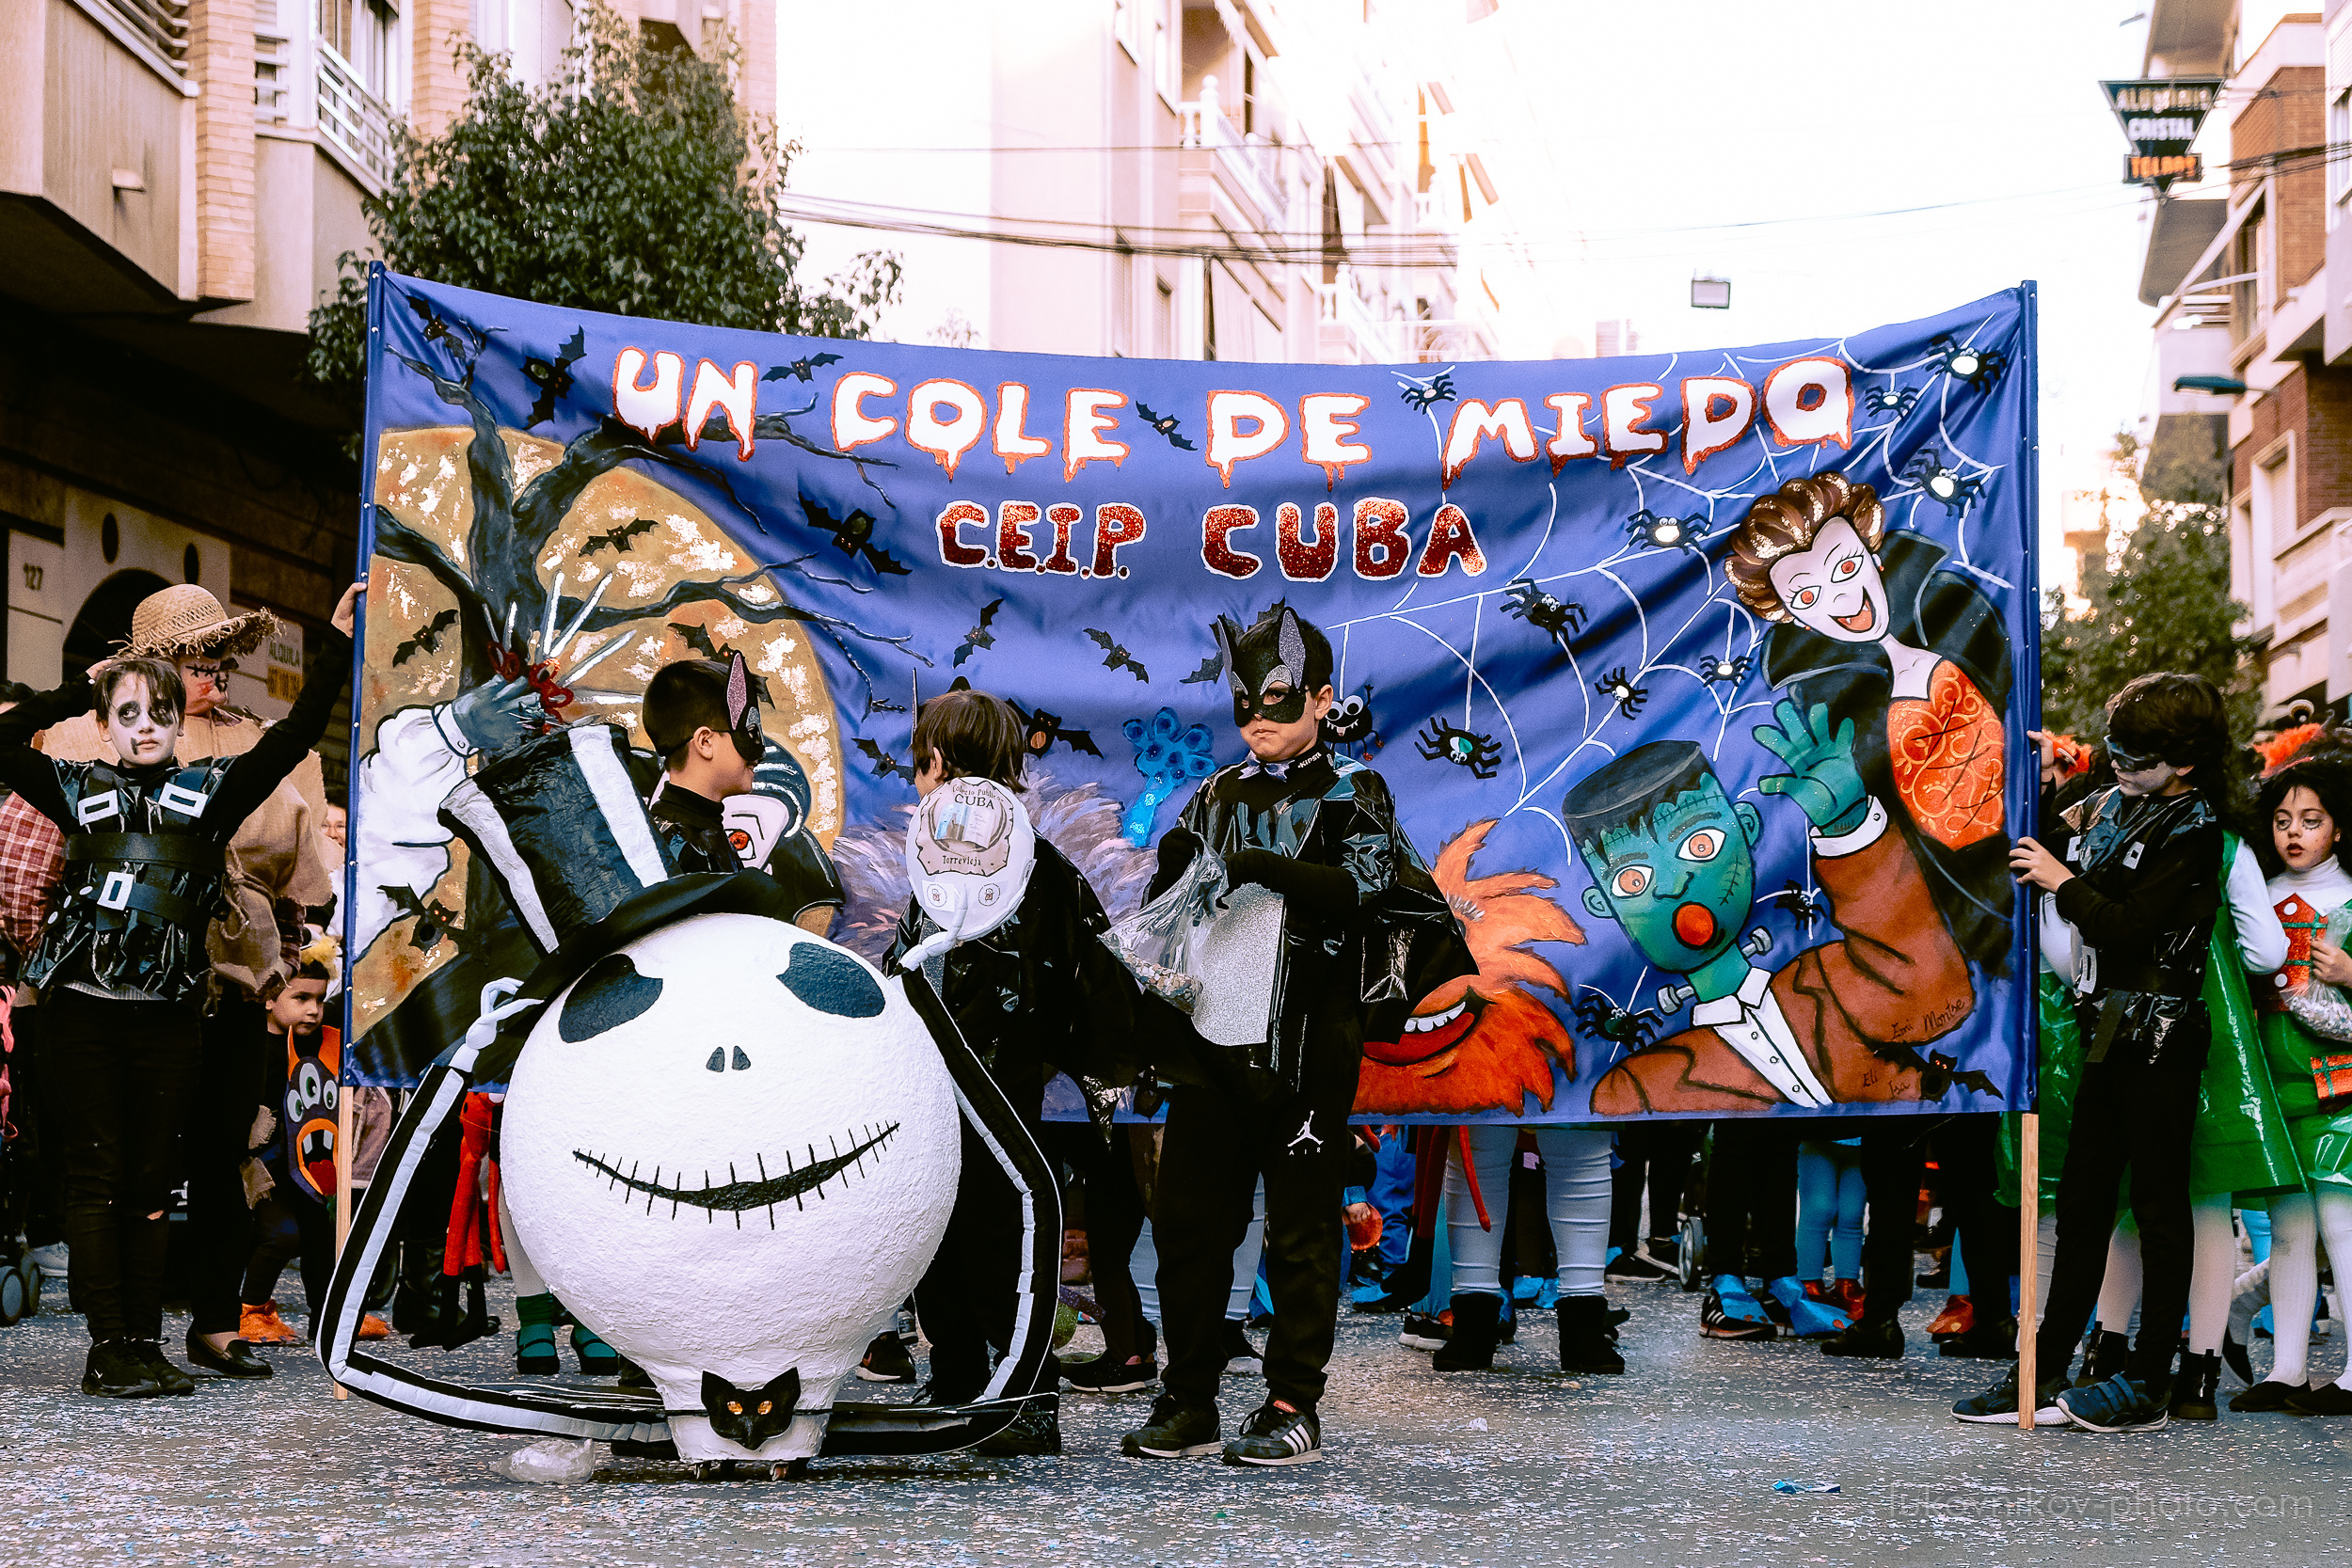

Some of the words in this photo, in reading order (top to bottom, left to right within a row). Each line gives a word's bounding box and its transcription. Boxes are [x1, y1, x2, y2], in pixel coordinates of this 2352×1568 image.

[2128, 118, 2196, 140] CRISTAL
[612, 345, 758, 462] UN
[831, 372, 1130, 482] COLE
[1206, 389, 1372, 491] DE
[1441, 356, 1853, 490] MIEDO
[935, 499, 1147, 579] C.E.I.P.
[1200, 497, 1487, 582] CUBA
[24, 562, 43, 591] 127
[954, 793, 994, 810] CUBA
[943, 855, 981, 866] Torrevieja
[1891, 1018, 1914, 1040] Emi
[1922, 998, 1965, 1033] Montse
[1887, 1079, 1911, 1100] Isa
[1289, 1147, 1321, 1156] AIR
